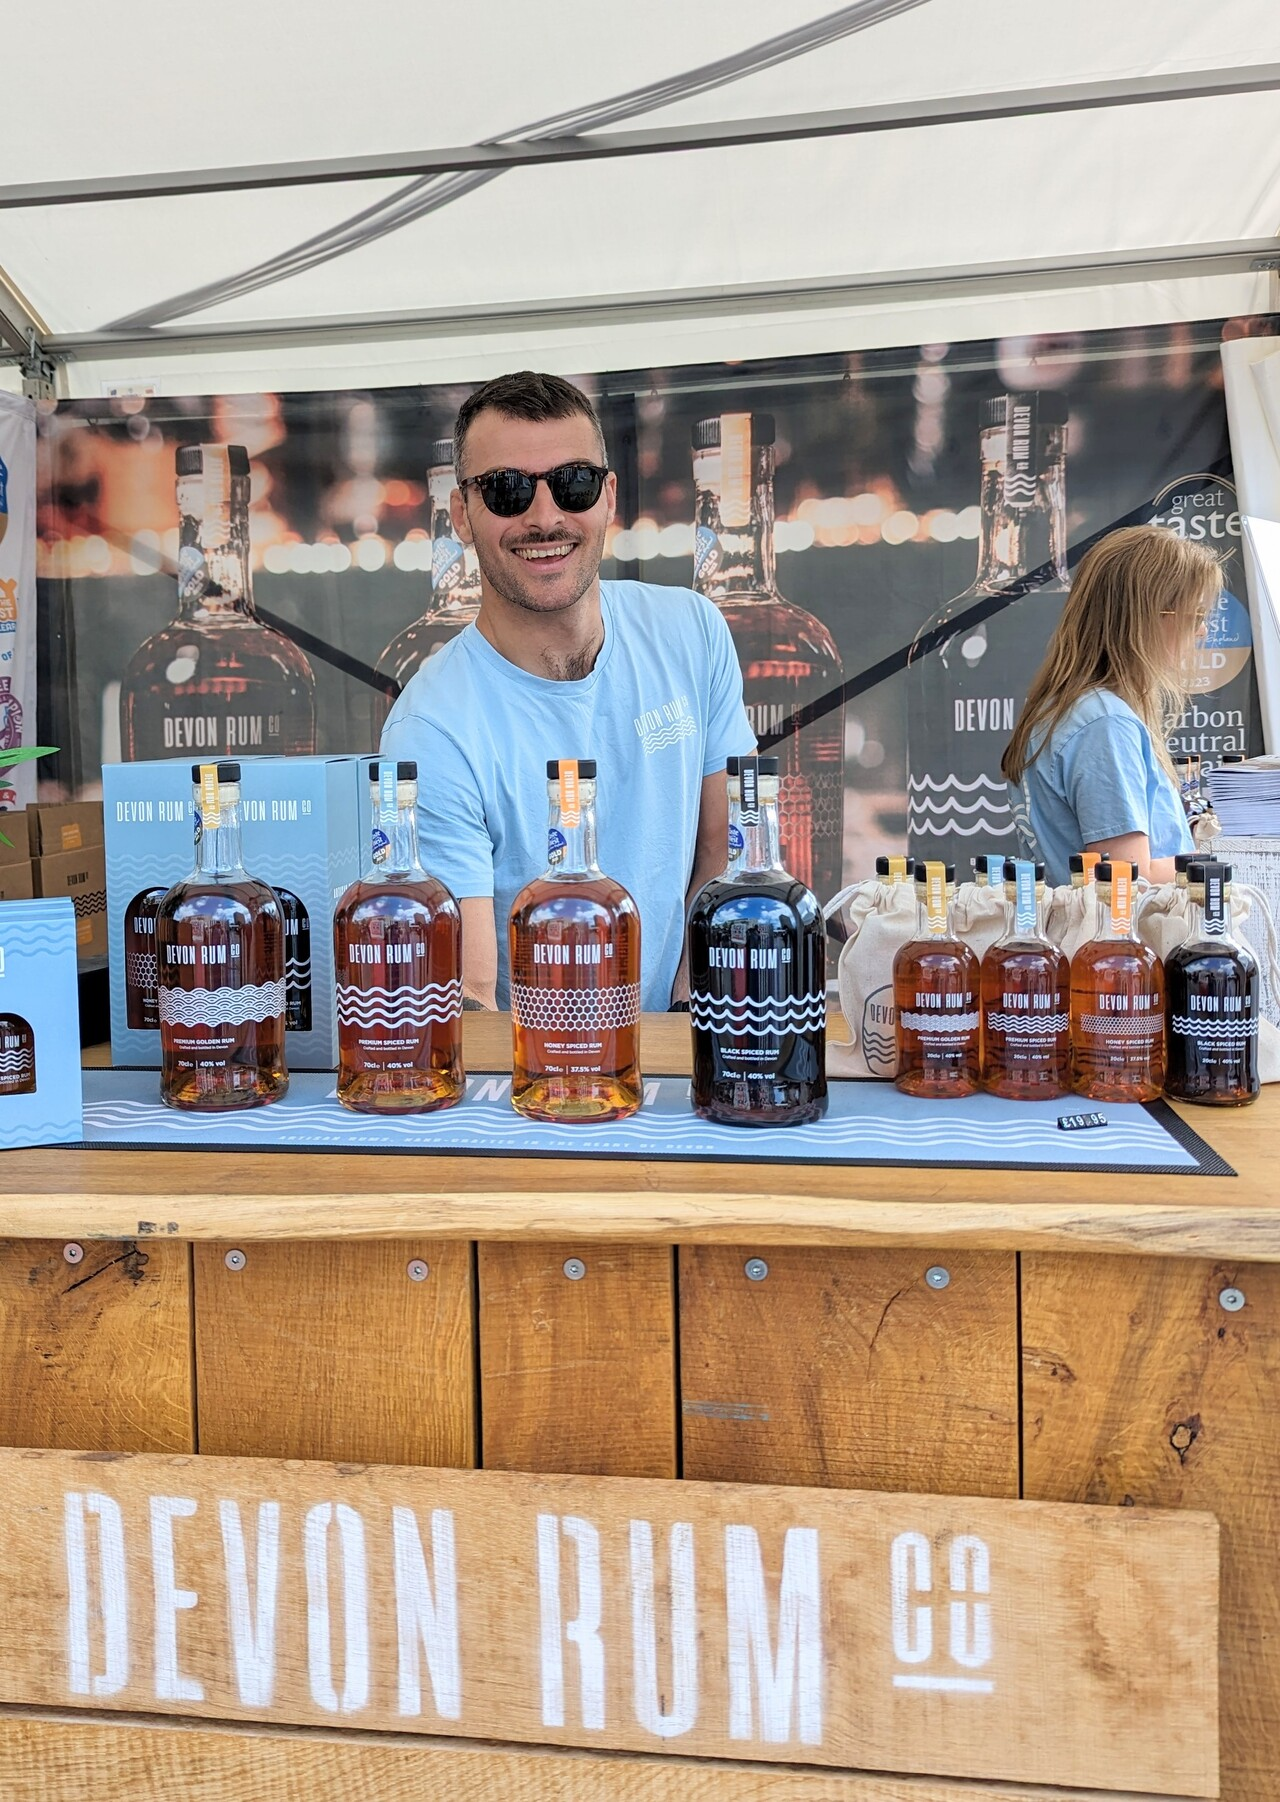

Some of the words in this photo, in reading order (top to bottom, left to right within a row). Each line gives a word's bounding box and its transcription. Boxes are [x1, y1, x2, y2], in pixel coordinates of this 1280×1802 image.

[1013, 406, 1031, 436] DEVON
[1012, 440, 1029, 460] RUM
[1171, 489, 1225, 515] great
[438, 562, 461, 589] GOLD
[1, 651, 12, 661] OF
[954, 698, 1015, 731] DEVON
[1163, 705, 1244, 730] arbon
[164, 716, 217, 748] DEVON
[226, 715, 262, 746] RUM
[268, 714, 280, 736] CO
[1165, 728, 1246, 753] eutral
[116, 801, 153, 822] DEVON
[159, 800, 185, 822] RUM
[240, 800, 273, 822] VON
[272, 800, 298, 821] RUM
[302, 799, 312, 815] CO
[133, 916, 156, 934] DEVO
[166, 944, 196, 965] DEVON
[201, 944, 227, 965] RUM
[230, 943, 240, 957] CO
[349, 943, 381, 964] DEVON
[386, 944, 412, 964] RUM
[416, 942, 425, 957] CO
[534, 943, 569, 965] DEVON
[575, 944, 601, 965] RUM
[604, 943, 614, 958] CO
[708, 946, 744, 969] DEVON
[750, 948, 778, 969] RUM
[781, 947, 791, 963] CO
[915, 991, 941, 1009] DEVON
[945, 992, 963, 1009] RUM
[1003, 992, 1029, 1009] DEVON
[1033, 993, 1051, 1009] RUM
[1099, 994, 1128, 1011] DEVON
[1133, 994, 1150, 1011] RUM
[1190, 995, 1219, 1012] DEVON
[1223, 996, 1242, 1012] RUM
[870, 1003, 895, 1026] DEVO
[4, 1034, 20, 1049] RUM
[720, 1047, 741, 1055] BLACK
[64, 1491, 462, 1721] DEVON
[536, 1512, 824, 1747] RUM
[889, 1530, 995, 1693] CO
